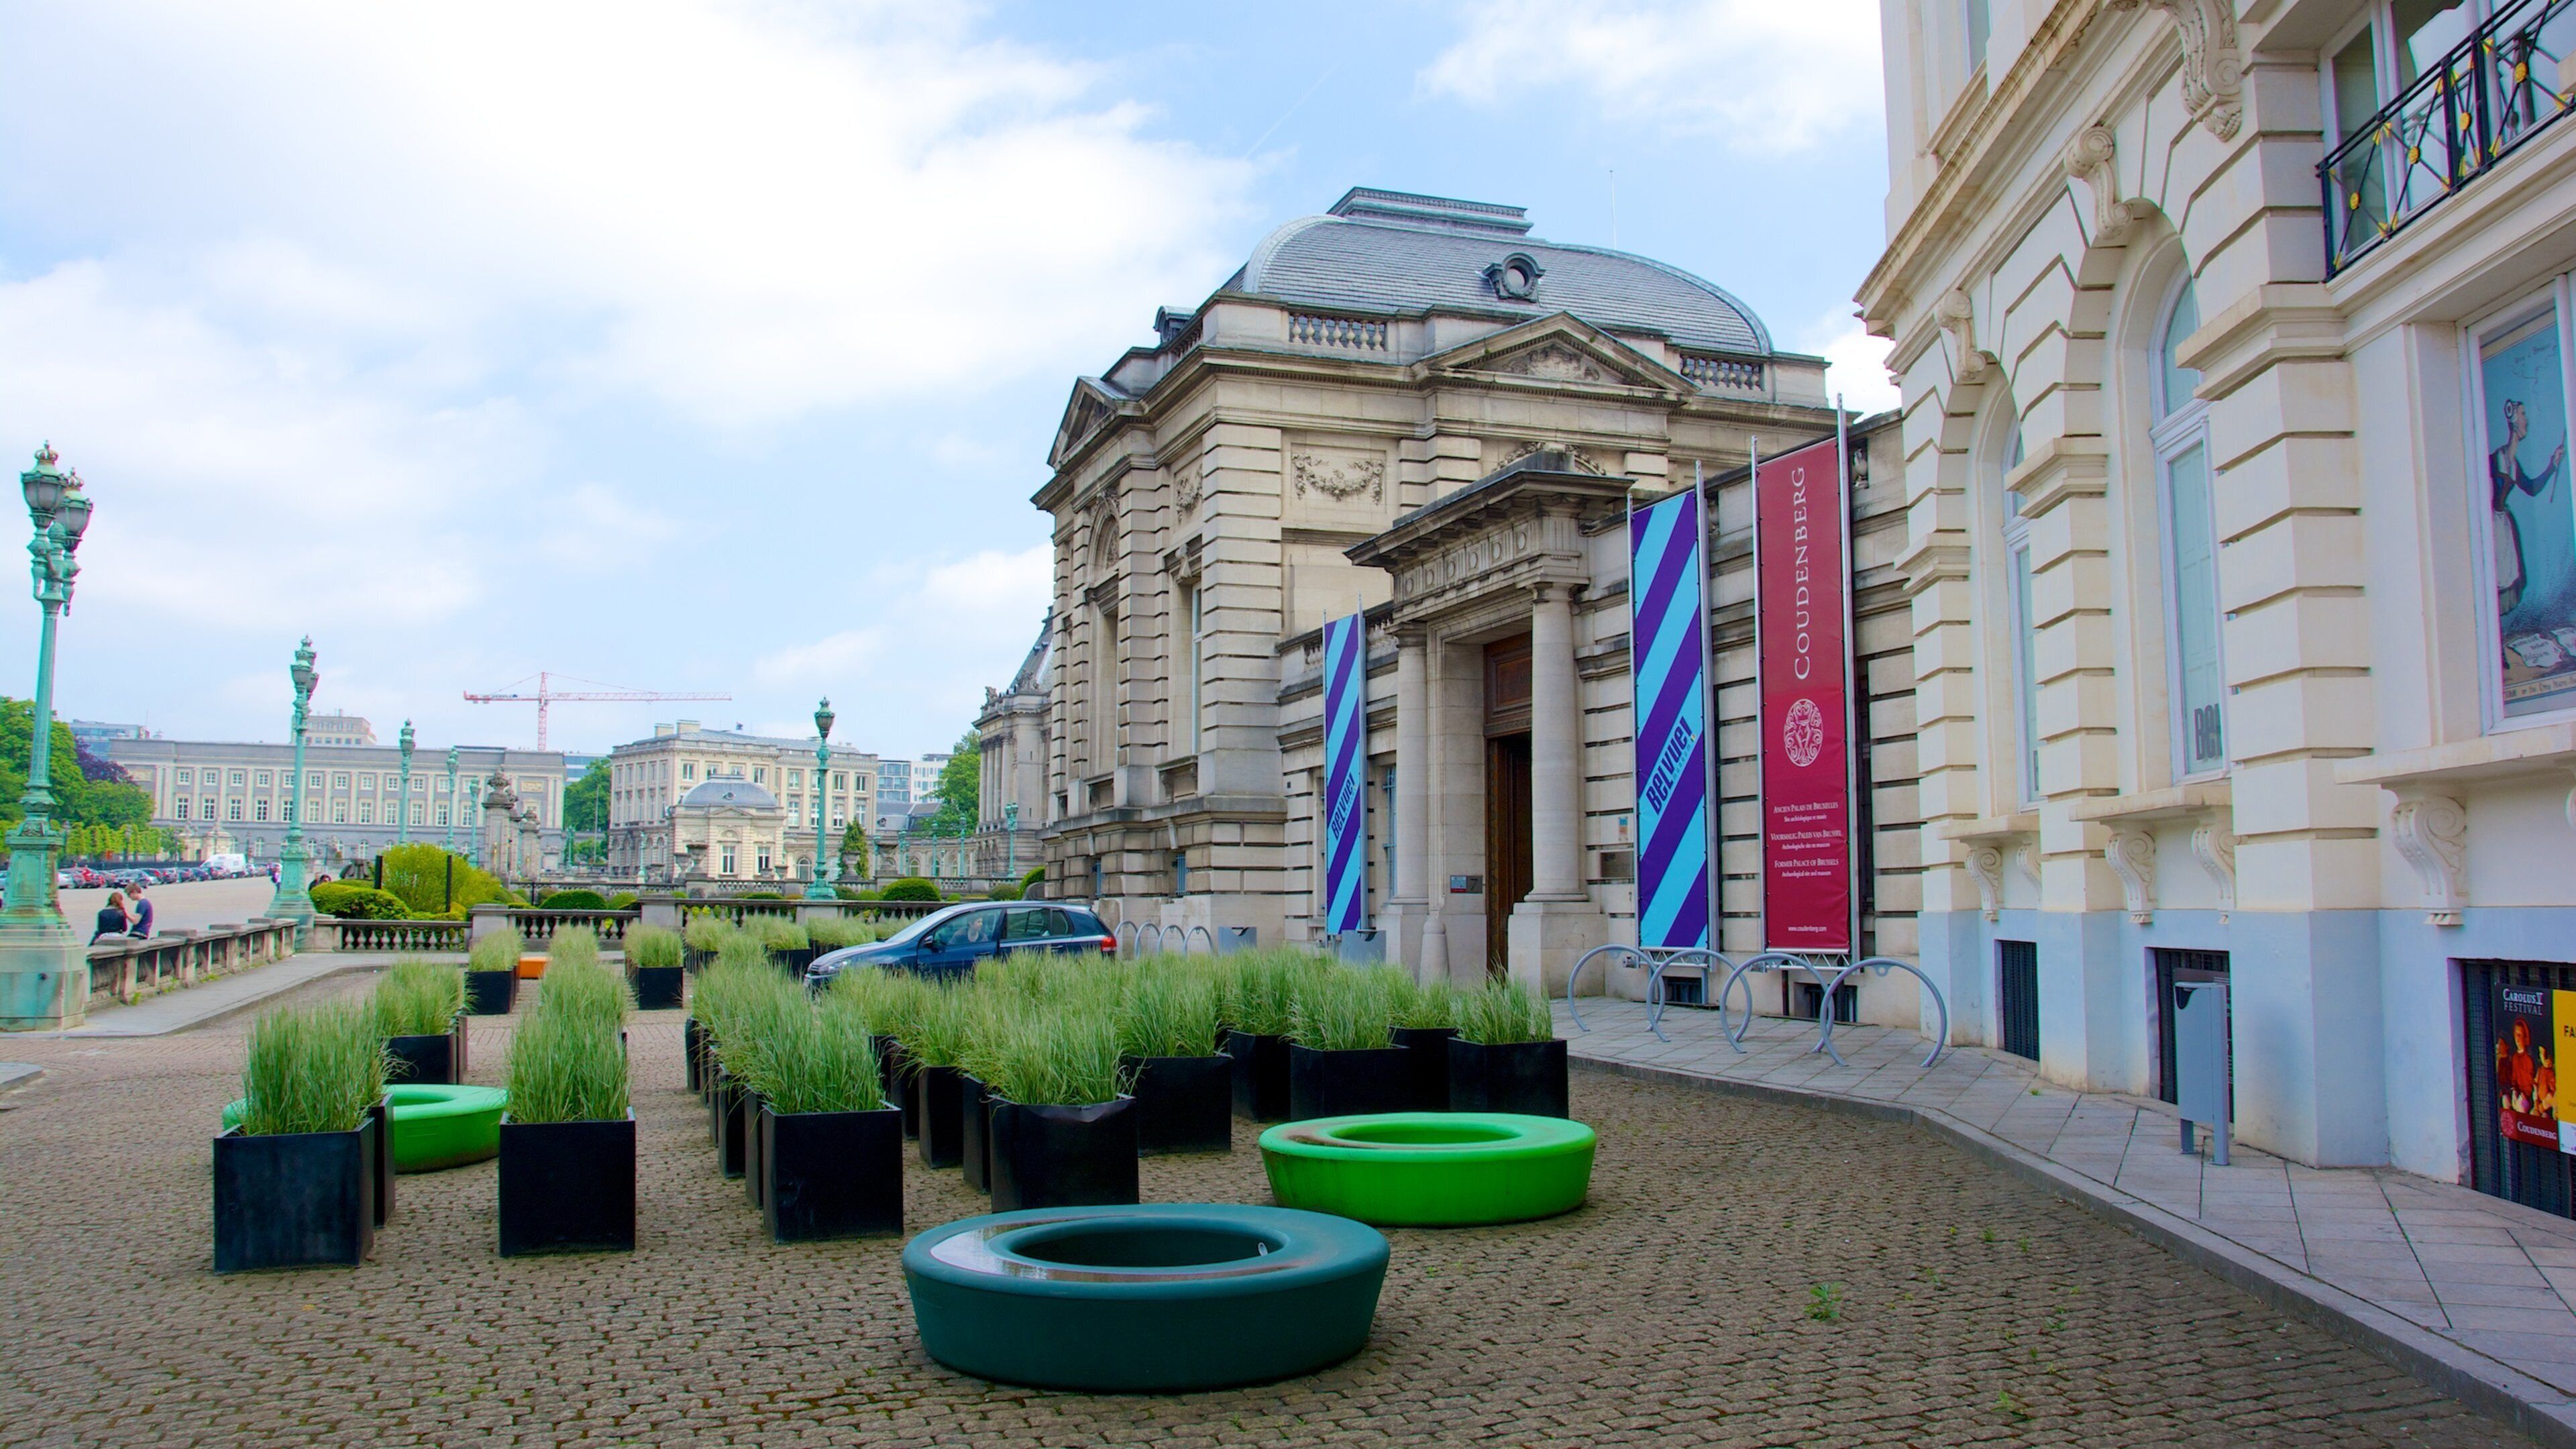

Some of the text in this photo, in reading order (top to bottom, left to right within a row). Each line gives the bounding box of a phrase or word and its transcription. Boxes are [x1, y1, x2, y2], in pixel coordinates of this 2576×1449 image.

[1792, 467, 1811, 680] COUDENBERG
[1773, 806, 1790, 814] ANCIEN
[1790, 804, 1806, 812] PALAIS
[1813, 802, 1839, 810] BRUXELLES
[1774, 860, 1792, 868] FORMER
[1793, 859, 1810, 867] PALACE
[1817, 858, 1839, 866] BRUSSELS
[1470, 878, 1478, 891] 7
[2502, 988, 2536, 1004] CAROLUS
[2504, 1001, 2542, 1016] FESTIVAL
[2564, 1025, 2576, 1038] FA
[2517, 1121, 2557, 1140] COUDENBERG
